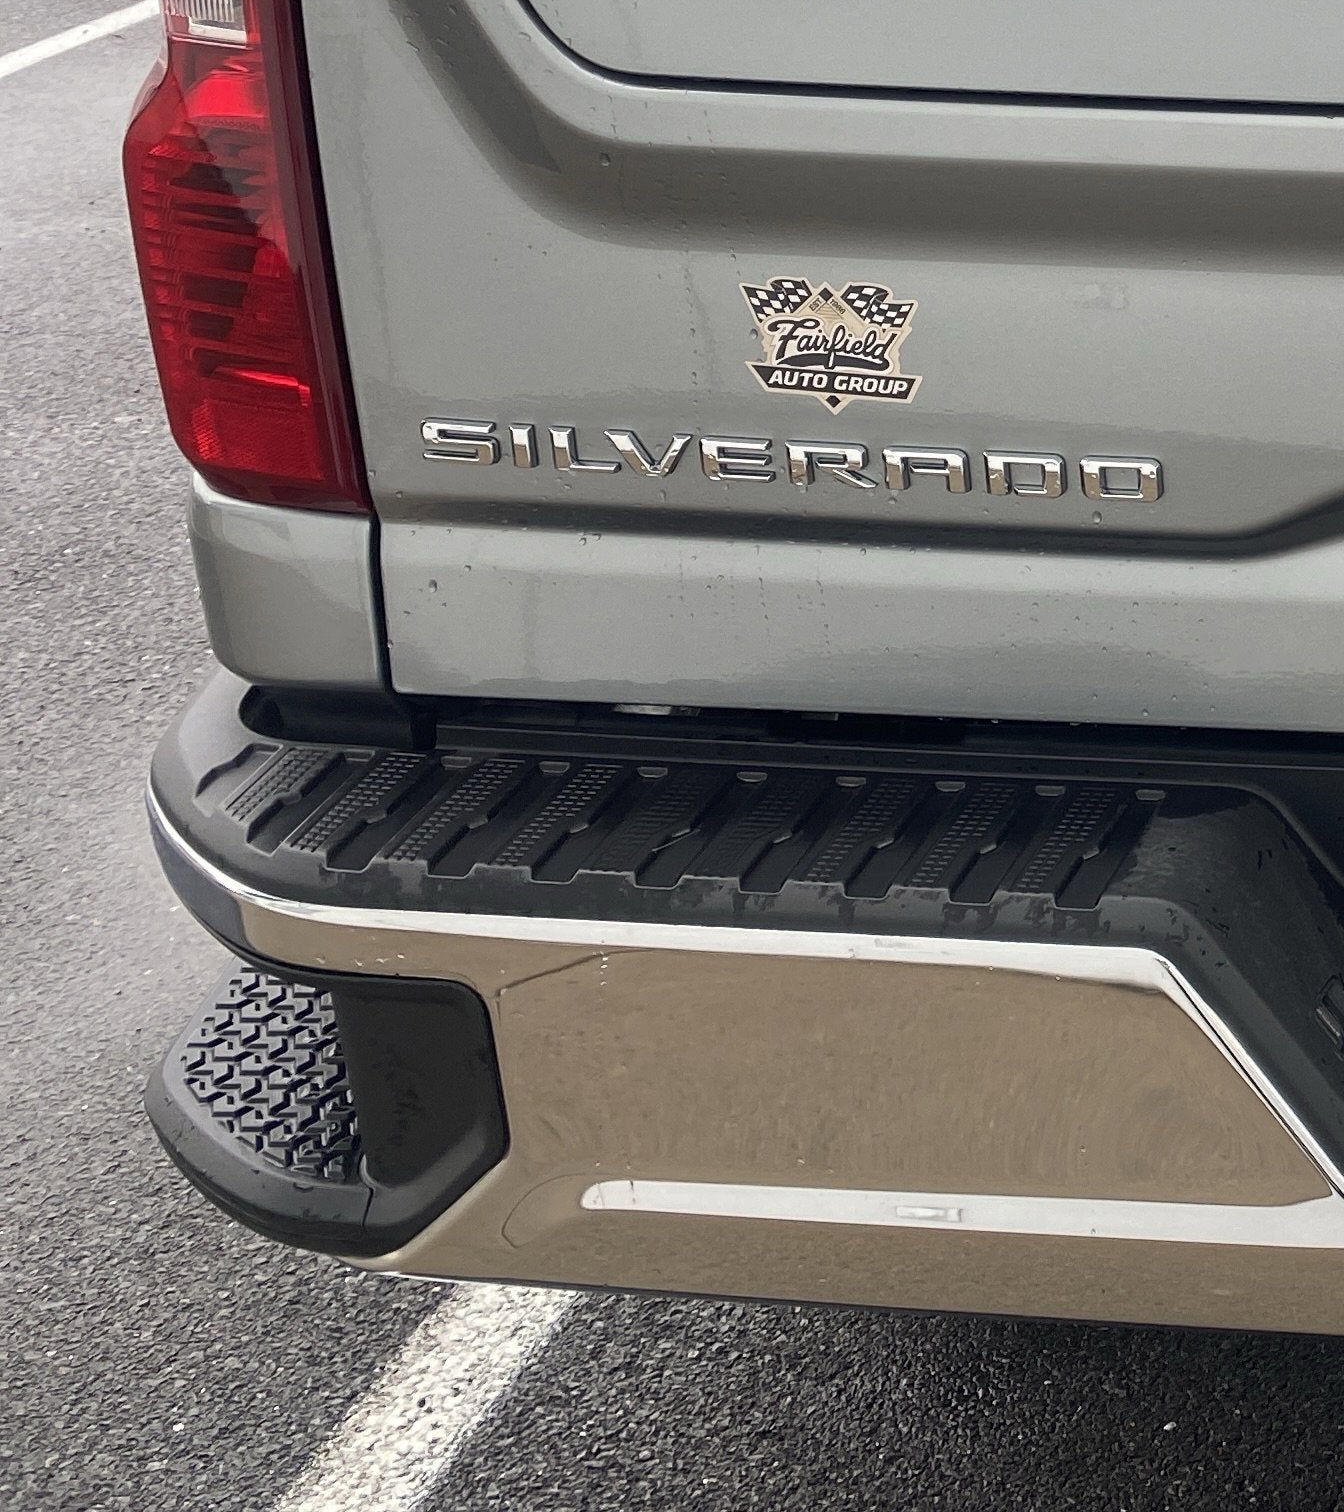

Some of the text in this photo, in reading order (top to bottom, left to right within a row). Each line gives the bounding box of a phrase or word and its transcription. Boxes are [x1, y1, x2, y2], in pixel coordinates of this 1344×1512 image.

[808, 297, 823, 312] EST
[767, 318, 898, 364] Fairfield
[768, 369, 908, 395] AUTO GROUP
[419, 417, 1164, 503] SILVERADO
